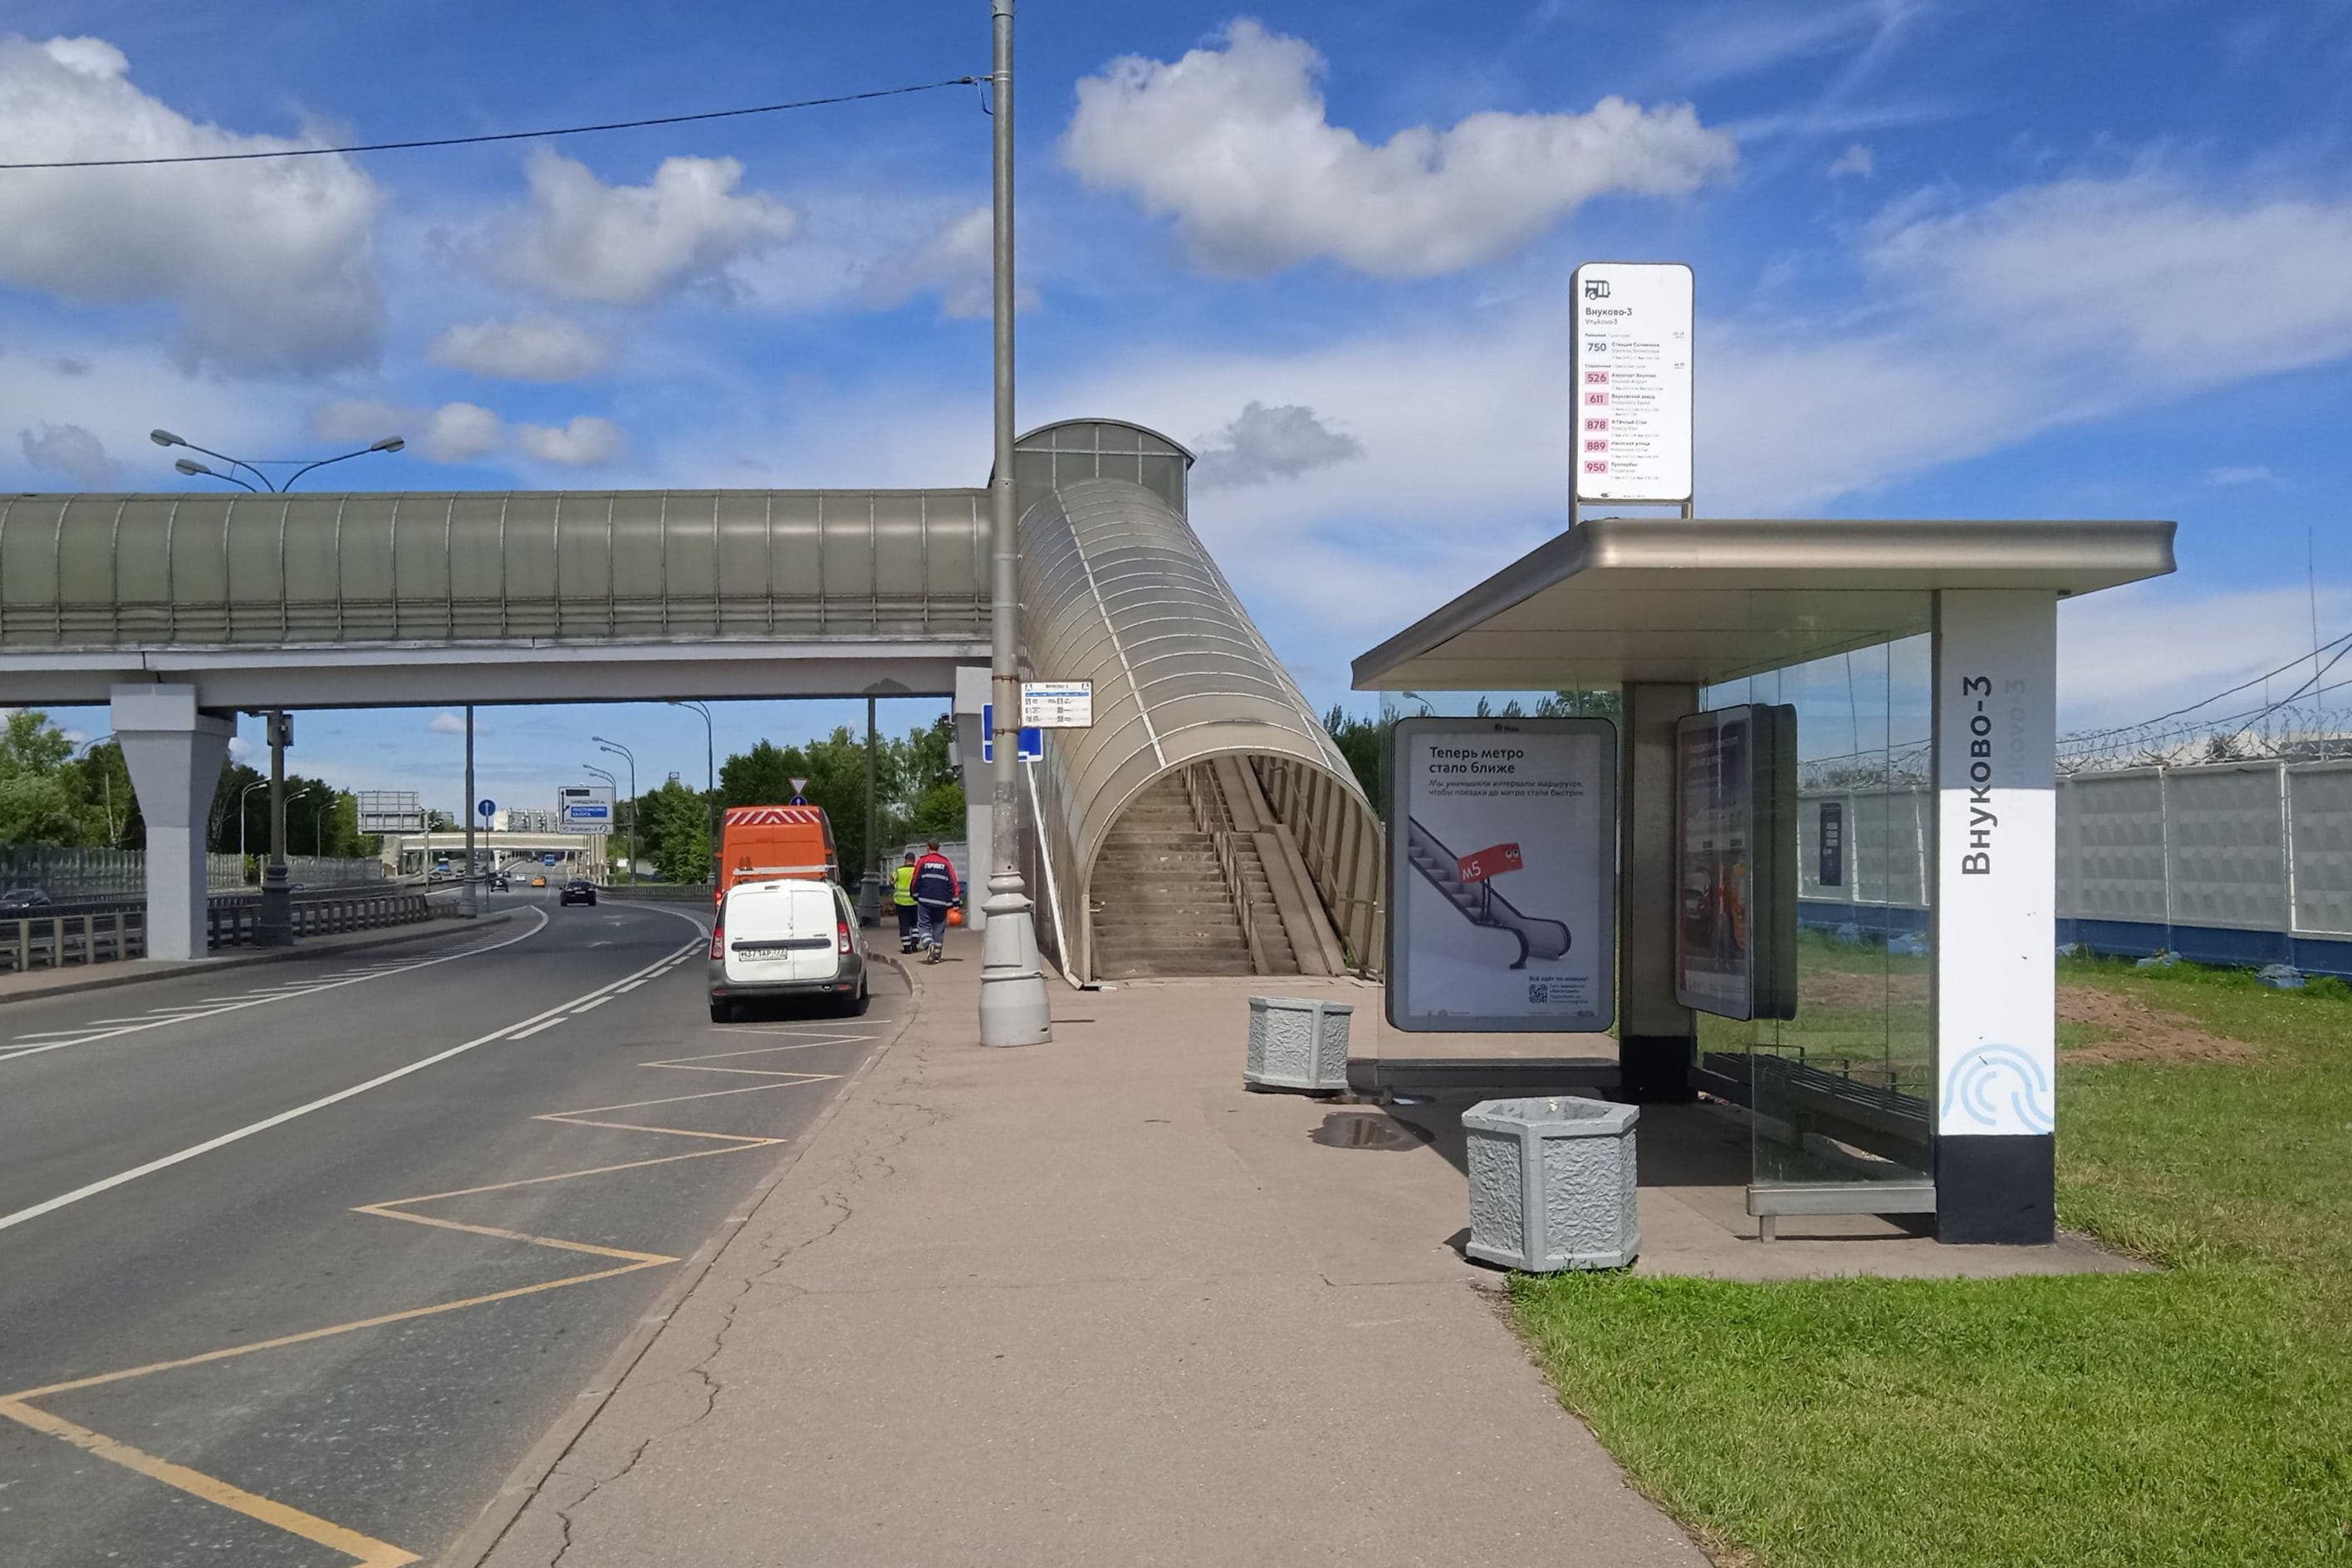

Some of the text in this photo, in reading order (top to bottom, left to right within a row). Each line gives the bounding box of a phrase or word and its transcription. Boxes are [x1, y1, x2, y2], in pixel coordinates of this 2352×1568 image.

[1585, 307, 1633, 317] Внуково-3
[1588, 343, 1607, 351] 750
[1588, 374, 1606, 382] 526
[1590, 395, 1603, 404] 611
[1587, 420, 1606, 429] 878
[1587, 442, 1605, 451] 889
[1586, 463, 1605, 472] 950
[1429, 747, 1524, 761] Теперь метро
[1429, 762, 1516, 773] стало ближе
[1962, 676, 1997, 875] Внуково-3
